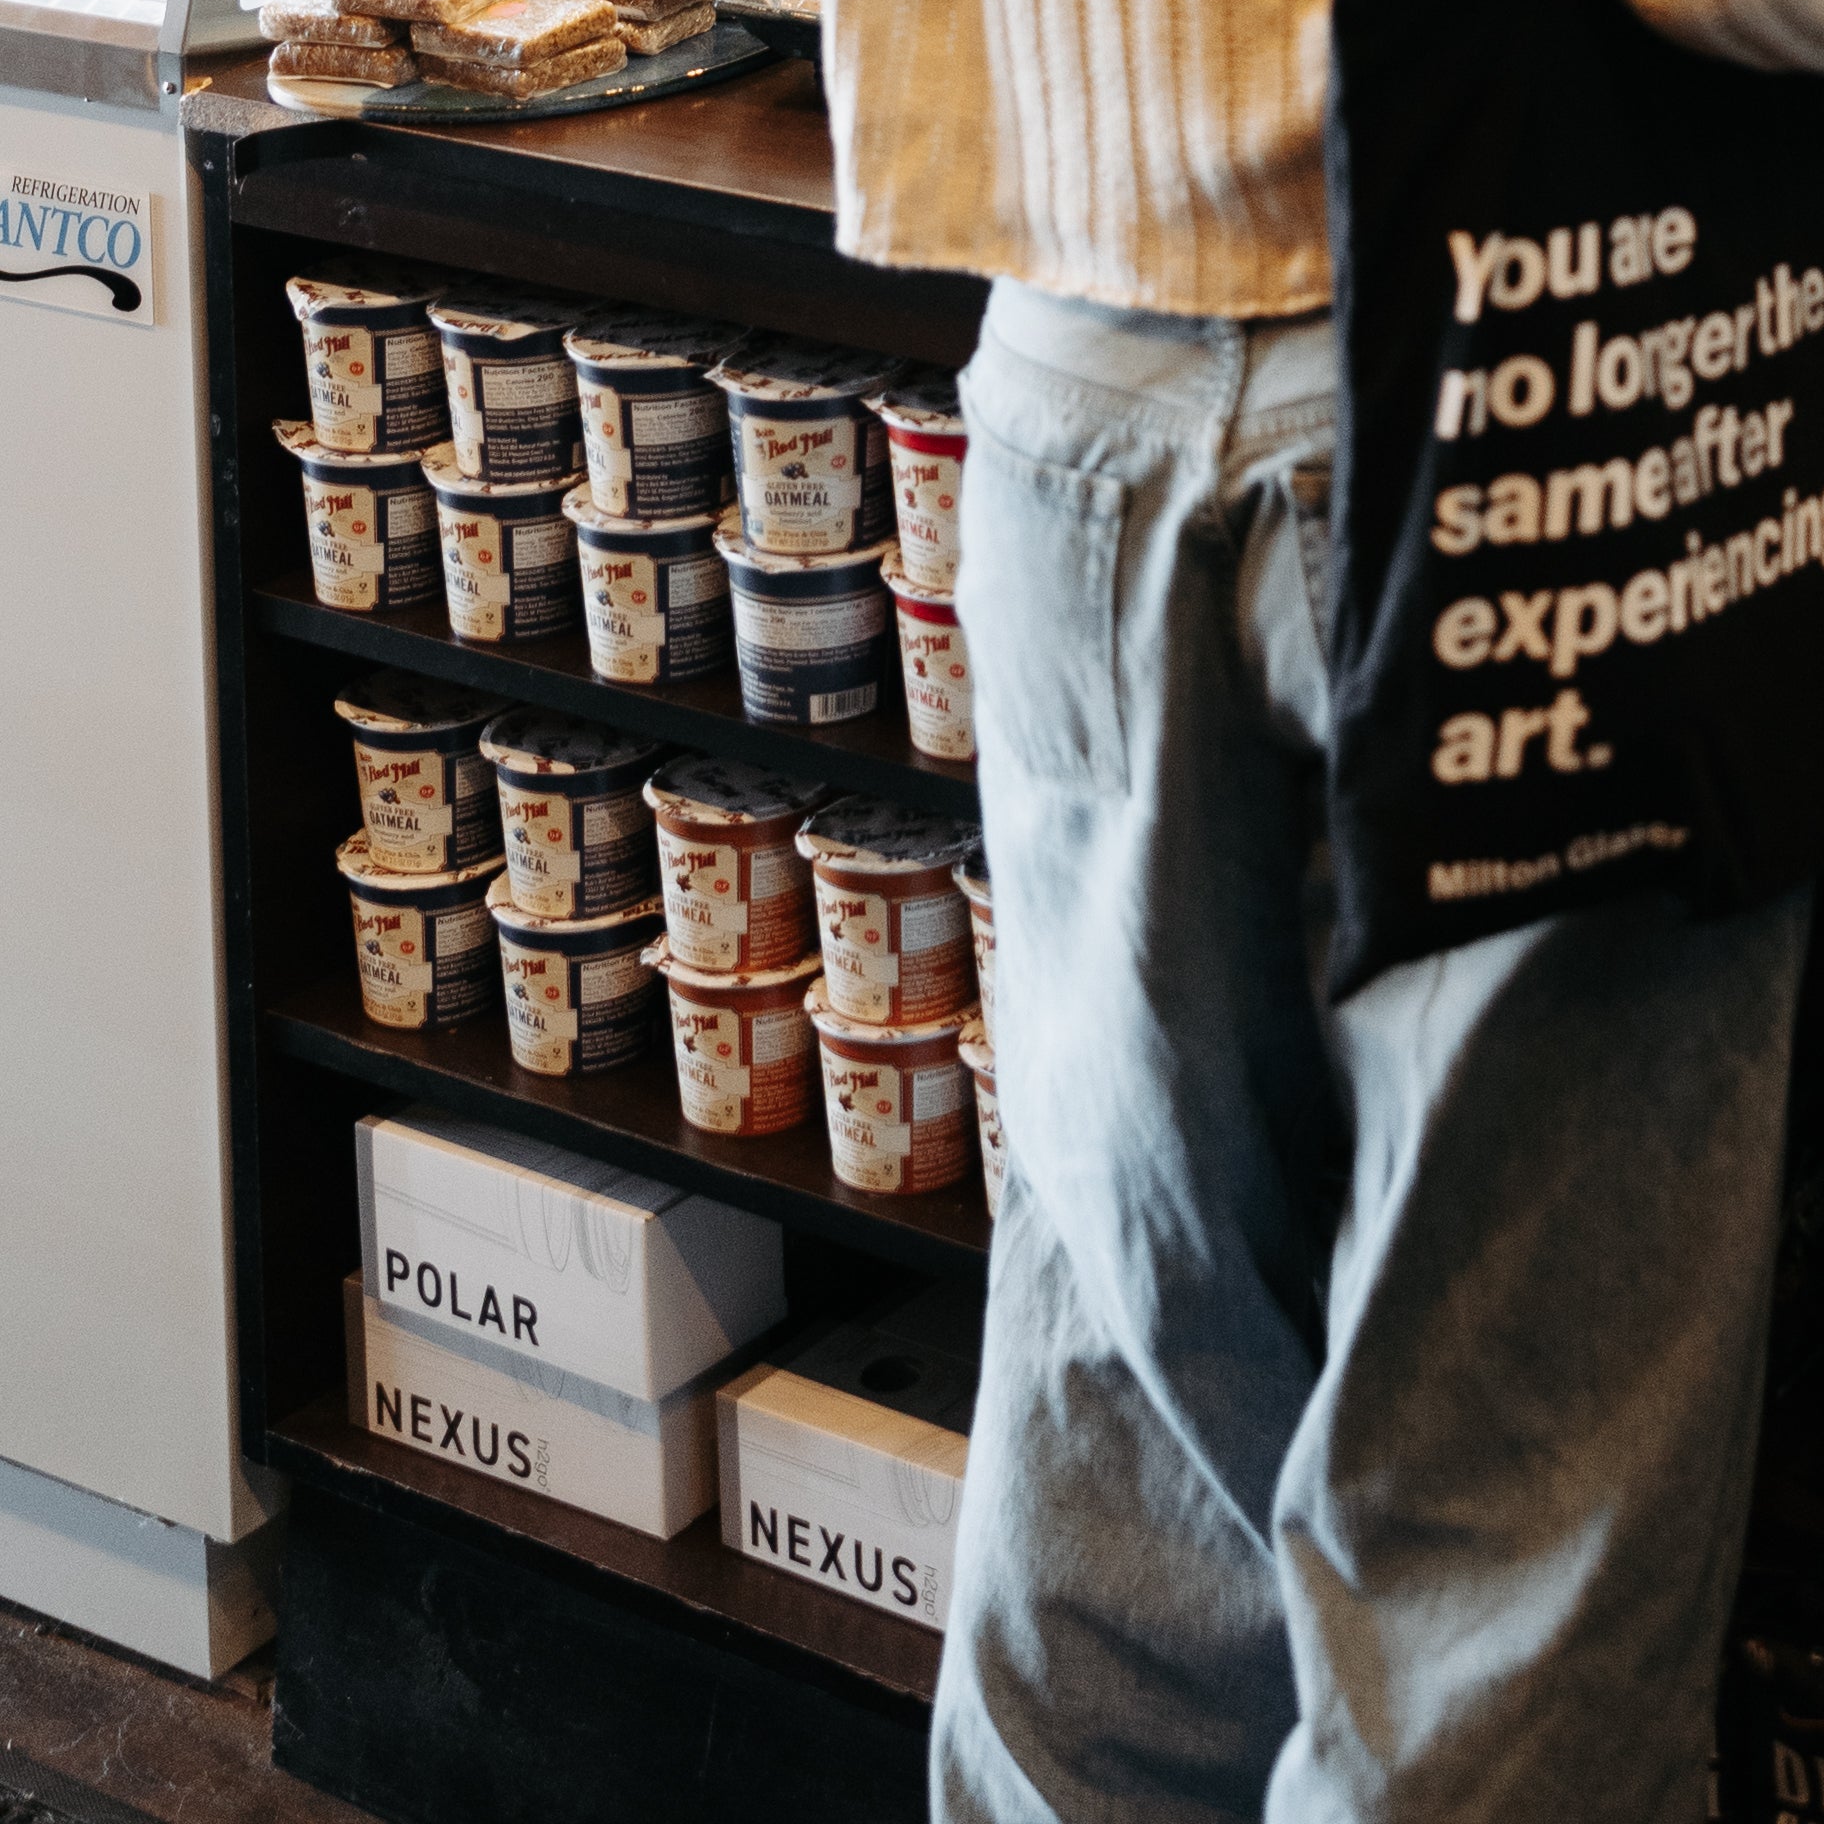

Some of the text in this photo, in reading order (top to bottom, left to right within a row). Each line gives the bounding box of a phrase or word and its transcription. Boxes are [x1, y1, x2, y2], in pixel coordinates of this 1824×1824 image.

[11, 175, 141, 215] REFRIGERATION
[1446, 204, 1698, 325] You are
[1432, 352, 1557, 444] no
[1566, 304, 1757, 419] longer
[767, 427, 834, 461] Red Mill
[1430, 398, 1795, 556] same after
[763, 489, 831, 508] OATMEAL
[391, 759, 422, 787] Mill
[1430, 687, 1614, 786] art.
[368, 809, 422, 832] OATMEAL
[384, 1246, 542, 1348] POLAR
[374, 1380, 533, 1481] NEXUS
[749, 1499, 920, 1607] NEXUS
